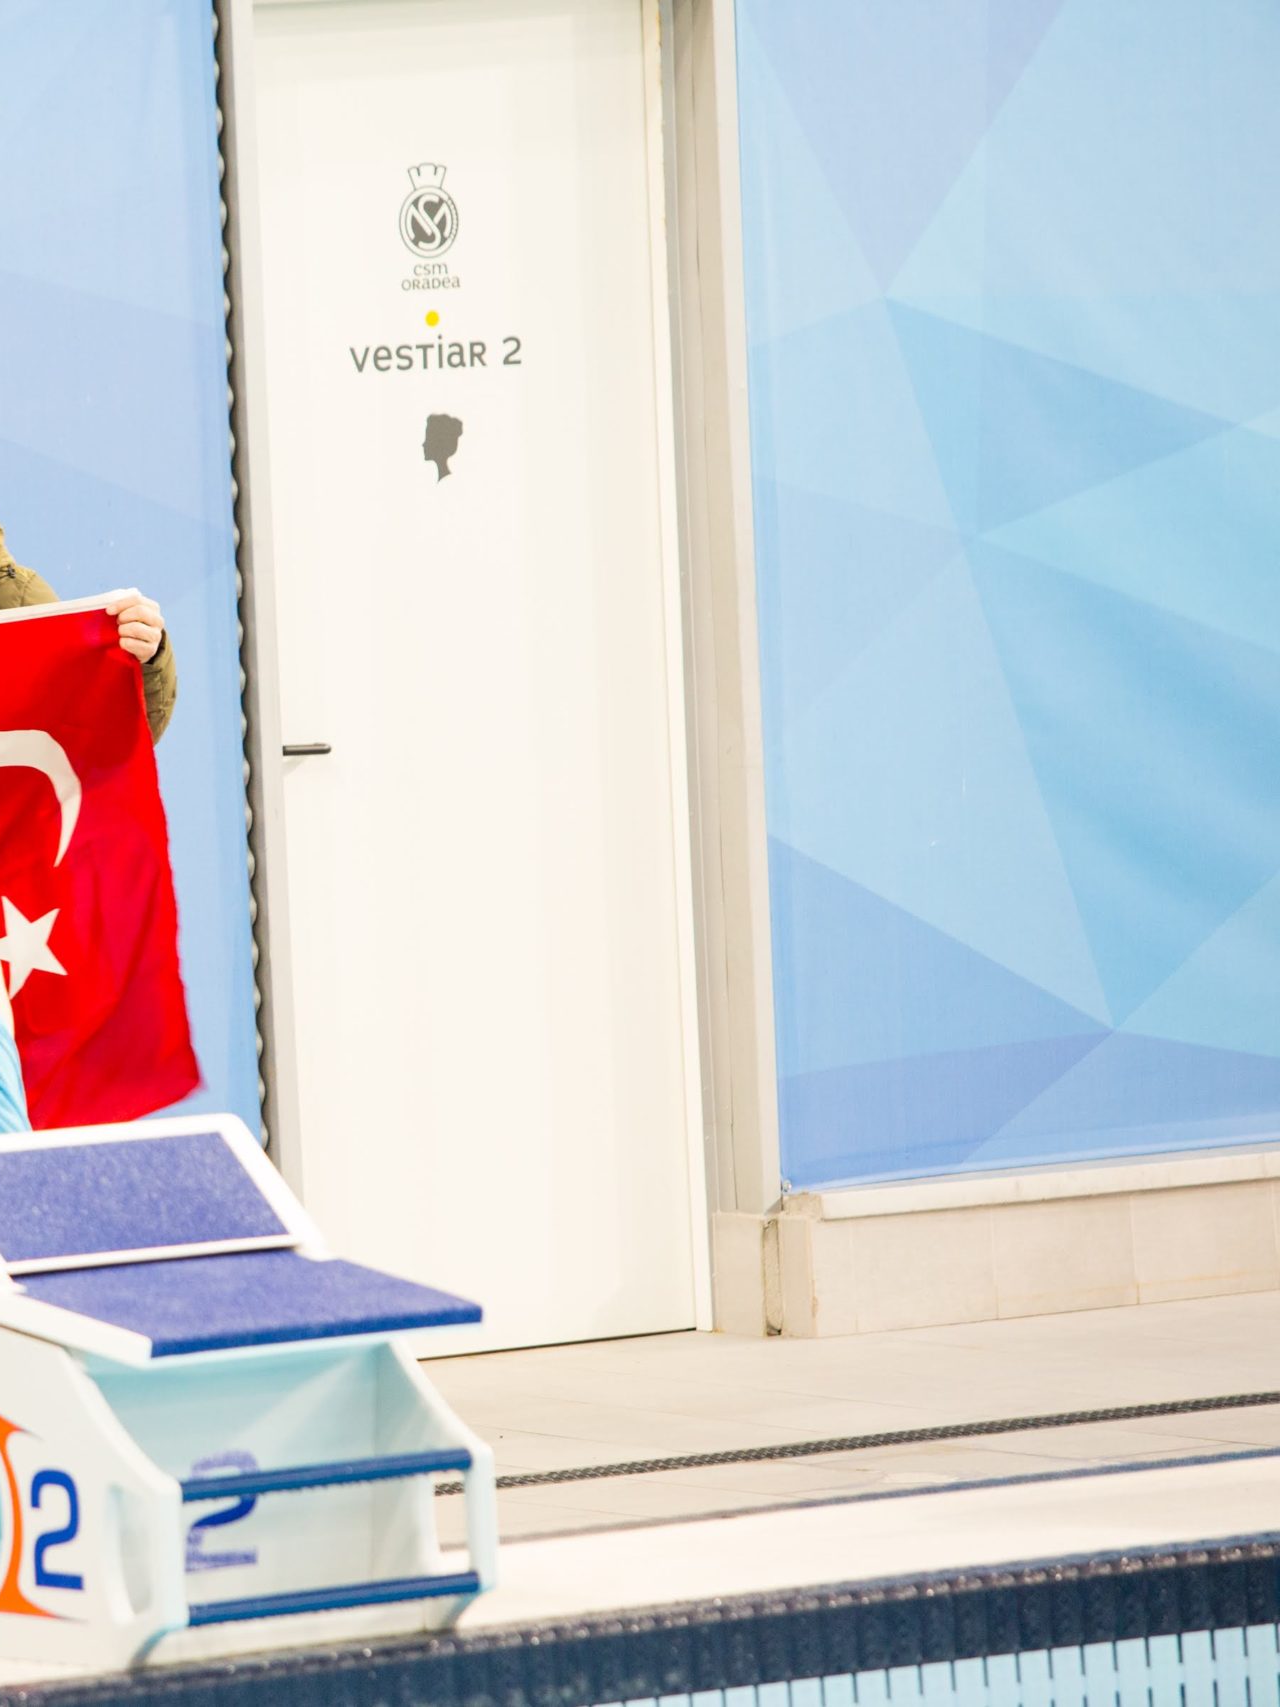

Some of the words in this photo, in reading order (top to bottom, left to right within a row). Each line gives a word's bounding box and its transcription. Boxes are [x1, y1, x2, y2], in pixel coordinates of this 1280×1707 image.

[413, 263, 448, 276] csm
[502, 336, 522, 365] 2
[30, 1469, 84, 1591] 2
[185, 1450, 258, 1572] 2
